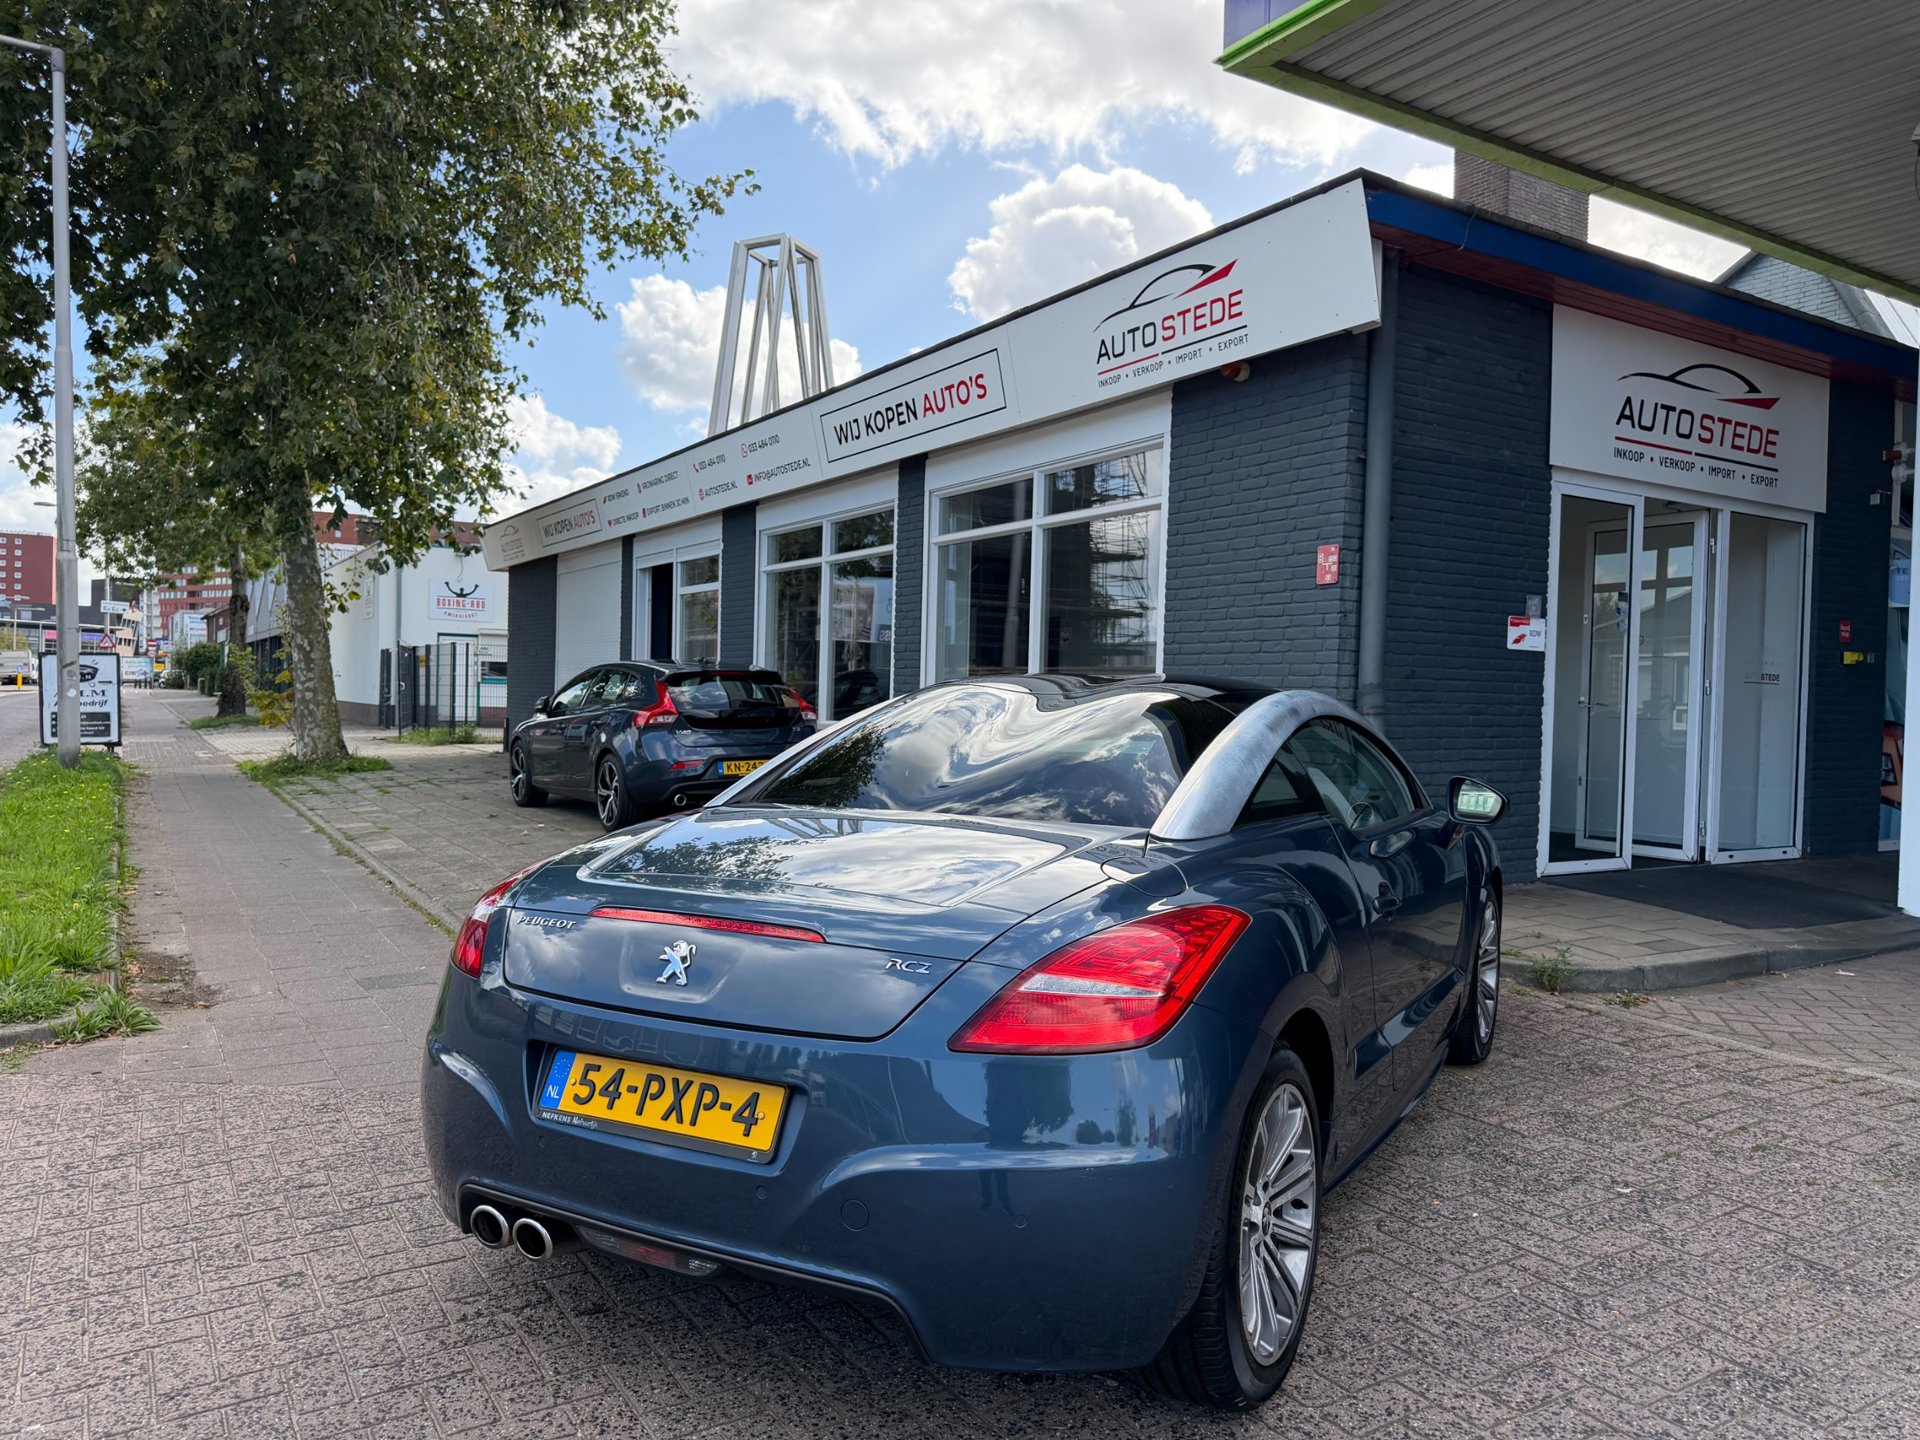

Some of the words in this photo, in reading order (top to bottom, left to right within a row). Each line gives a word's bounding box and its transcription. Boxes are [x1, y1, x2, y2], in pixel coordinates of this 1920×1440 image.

[1098, 374, 1121, 388] INKOOP
[1132, 361, 1163, 378] VERKOOP
[1175, 348, 1202, 364] IMPORT
[1218, 334, 1249, 351] EXPORT
[834, 418, 861, 445] WIJ
[864, 398, 918, 436] KOPEN
[923, 373, 987, 417] AUTO'S
[748, 444, 758, 453] 033
[758, 439, 769, 449] 484
[754, 457, 811, 483] INFO@AUTOSTEDE.NL
[1613, 447, 1644, 463] INKOOP
[1659, 455, 1696, 473] VERKOOP
[1708, 465, 1736, 481] IMPORT
[1750, 473, 1778, 489] EXPORT
[705, 481, 738, 497] AUTOSTEDE.NL
[554, 517, 574, 536] KOPEN
[574, 509, 596, 530] AUTO'S
[517, 915, 577, 929] PEUGEOT
[884, 957, 932, 975] RCZ
[546, 1084, 560, 1100] NL
[572, 1063, 762, 1137] 54-PXP-4
[541, 1111, 572, 1123] NEFKENS
